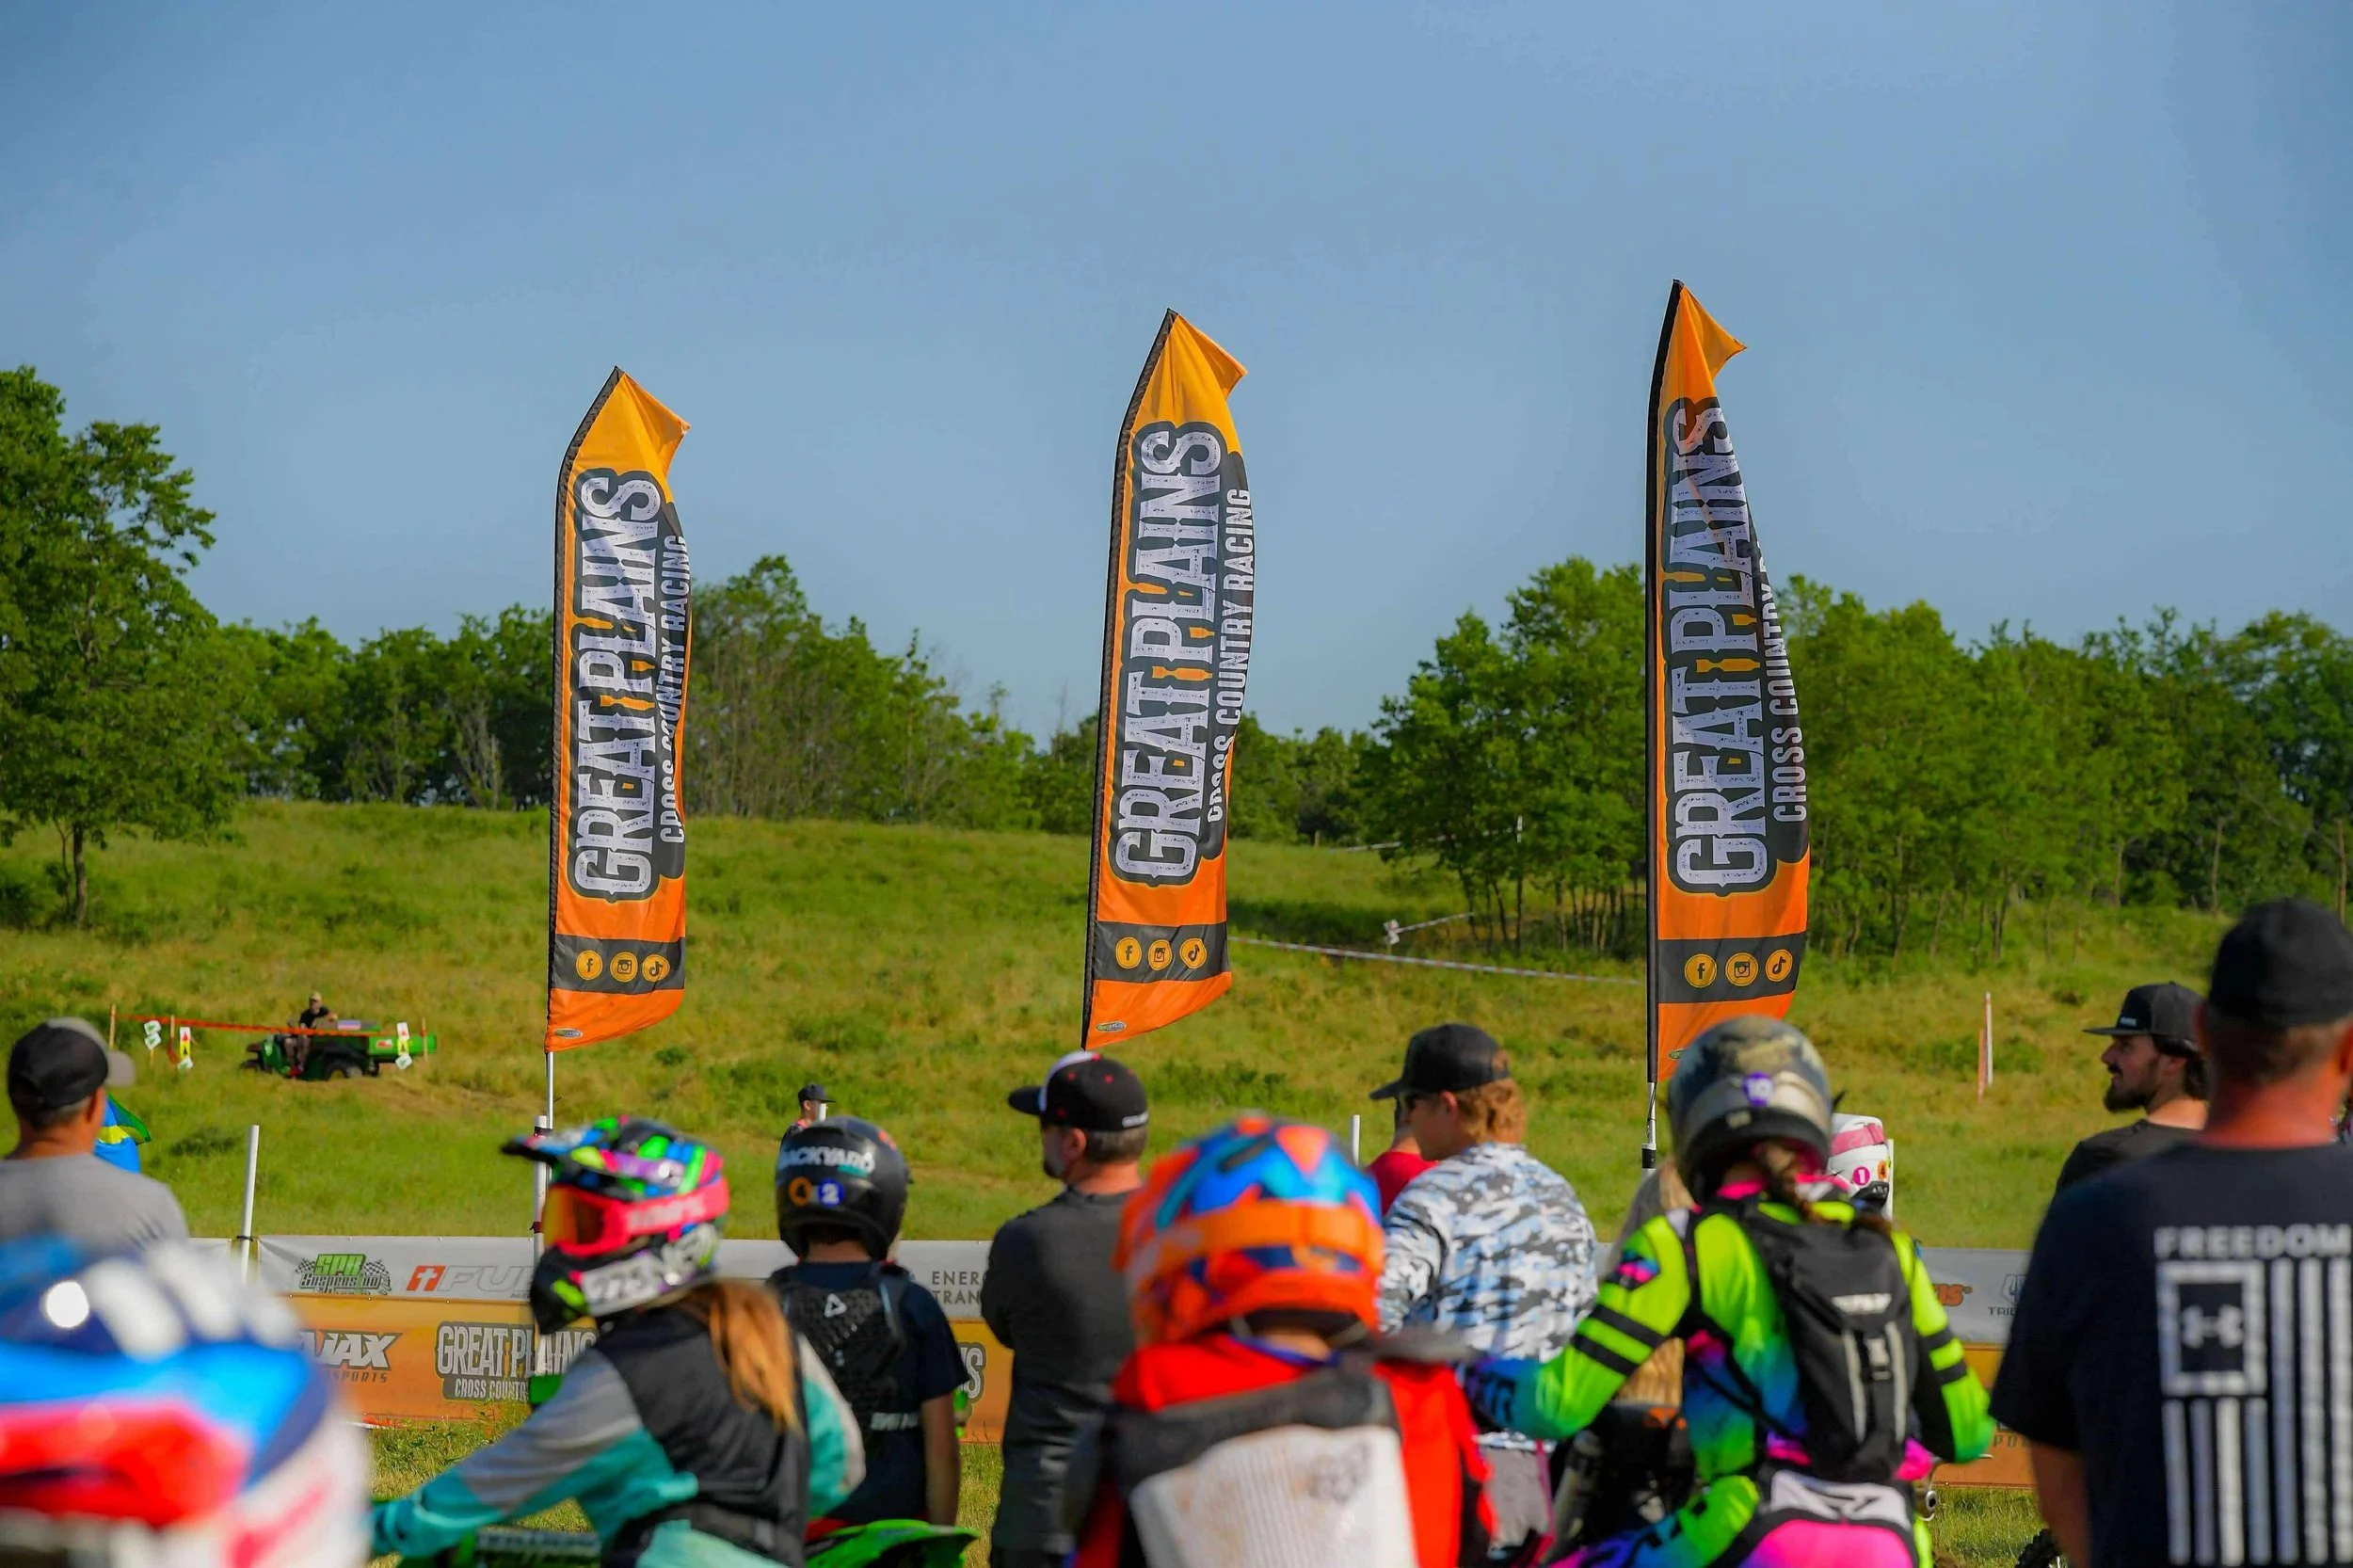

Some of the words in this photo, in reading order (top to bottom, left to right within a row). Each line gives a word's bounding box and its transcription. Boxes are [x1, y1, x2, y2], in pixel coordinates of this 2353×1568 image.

[578, 477, 661, 694] PLAINS
[661, 535, 691, 632] RACING
[1130, 430, 1221, 664] PLAINS
[1223, 488, 1255, 591] RACING
[1215, 600, 1253, 726] COUNTRY
[575, 699, 656, 894] GREAT
[1115, 671, 1210, 879] GREAT
[1671, 666, 1768, 888] GREAT
[1770, 726, 1807, 823] CROSS
[822, 1182, 840, 1205] 2
[1858, 1169, 1866, 1184] 1
[932, 1272, 984, 1286] ENER
[932, 1290, 981, 1304] TRAN
[438, 1325, 509, 1377] GREAT
[455, 1378, 487, 1400] CROSS
[488, 1380, 529, 1402] COUNTR
